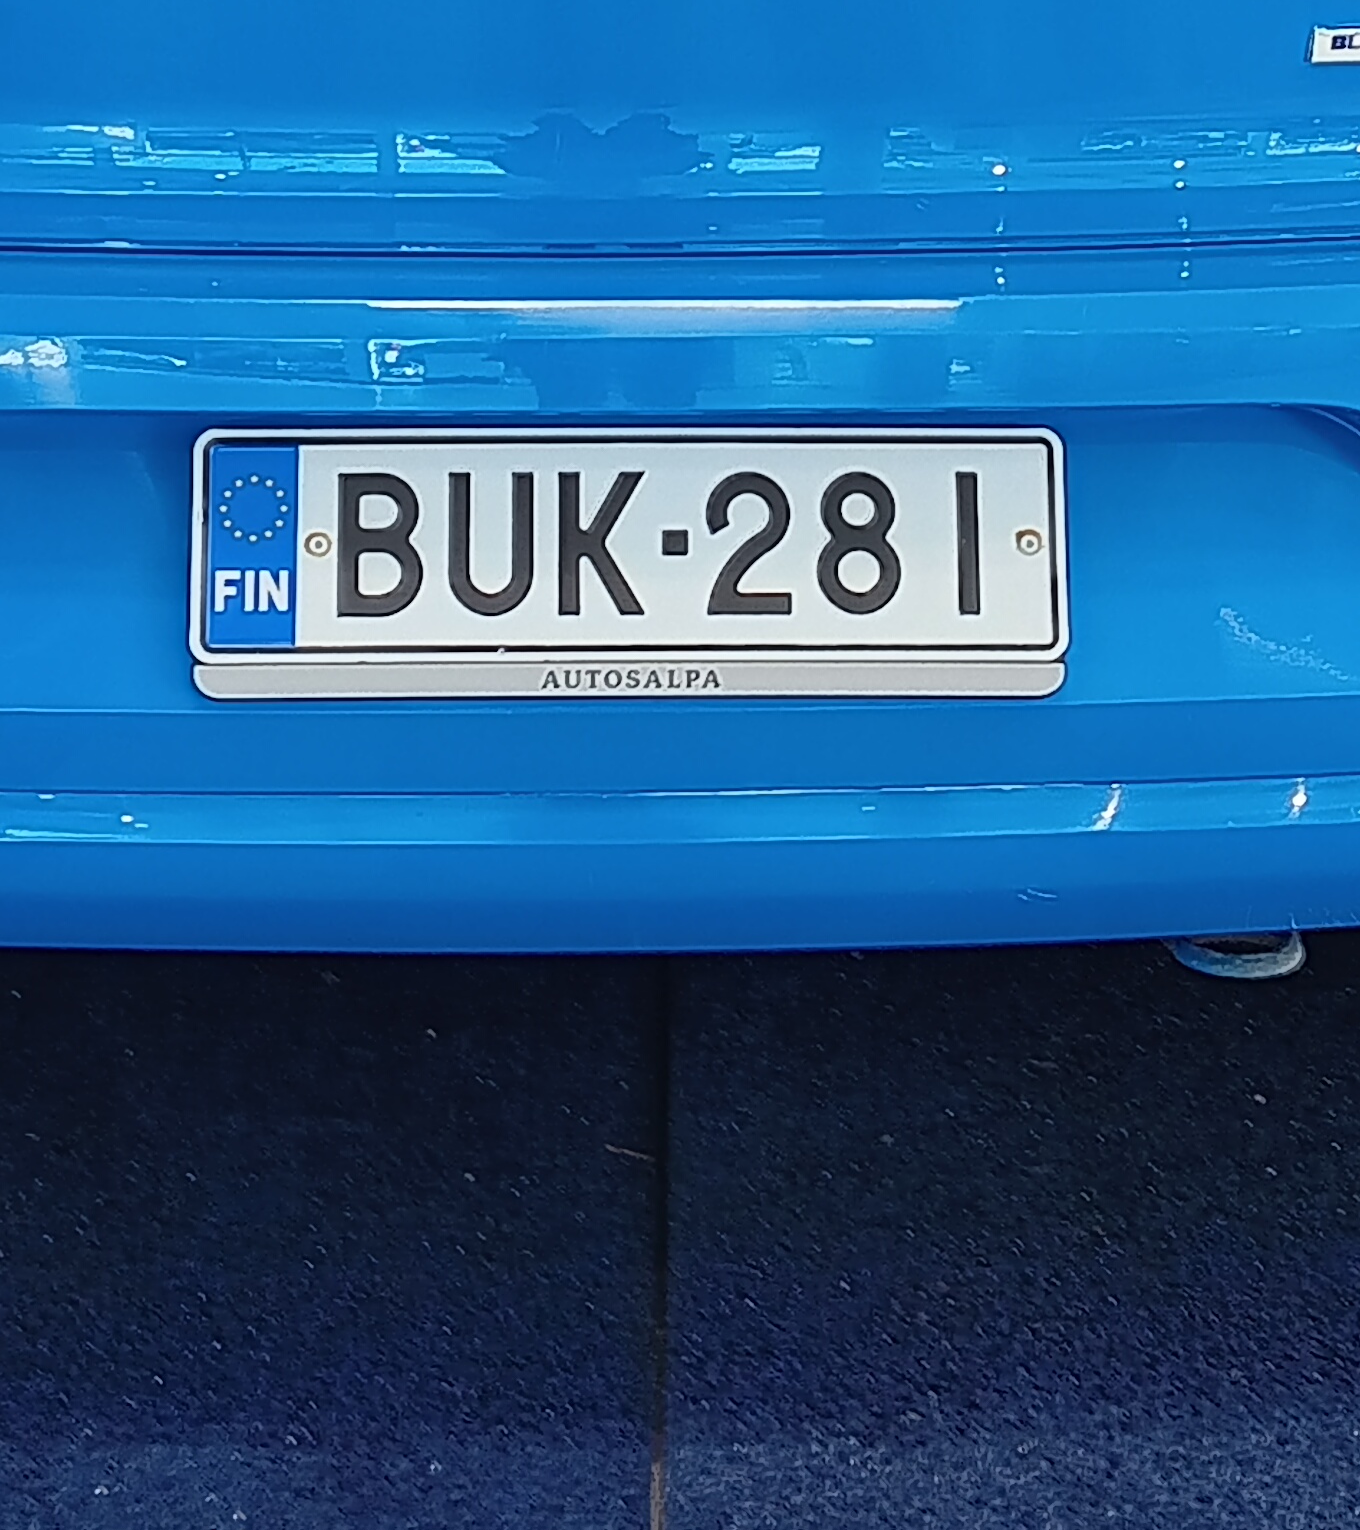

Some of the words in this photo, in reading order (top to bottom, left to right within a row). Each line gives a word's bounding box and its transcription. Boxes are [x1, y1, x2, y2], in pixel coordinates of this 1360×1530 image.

[335, 470, 982, 618] BUK-281
[213, 568, 291, 614] FIN
[540, 668, 722, 690] AUTOSALPA
